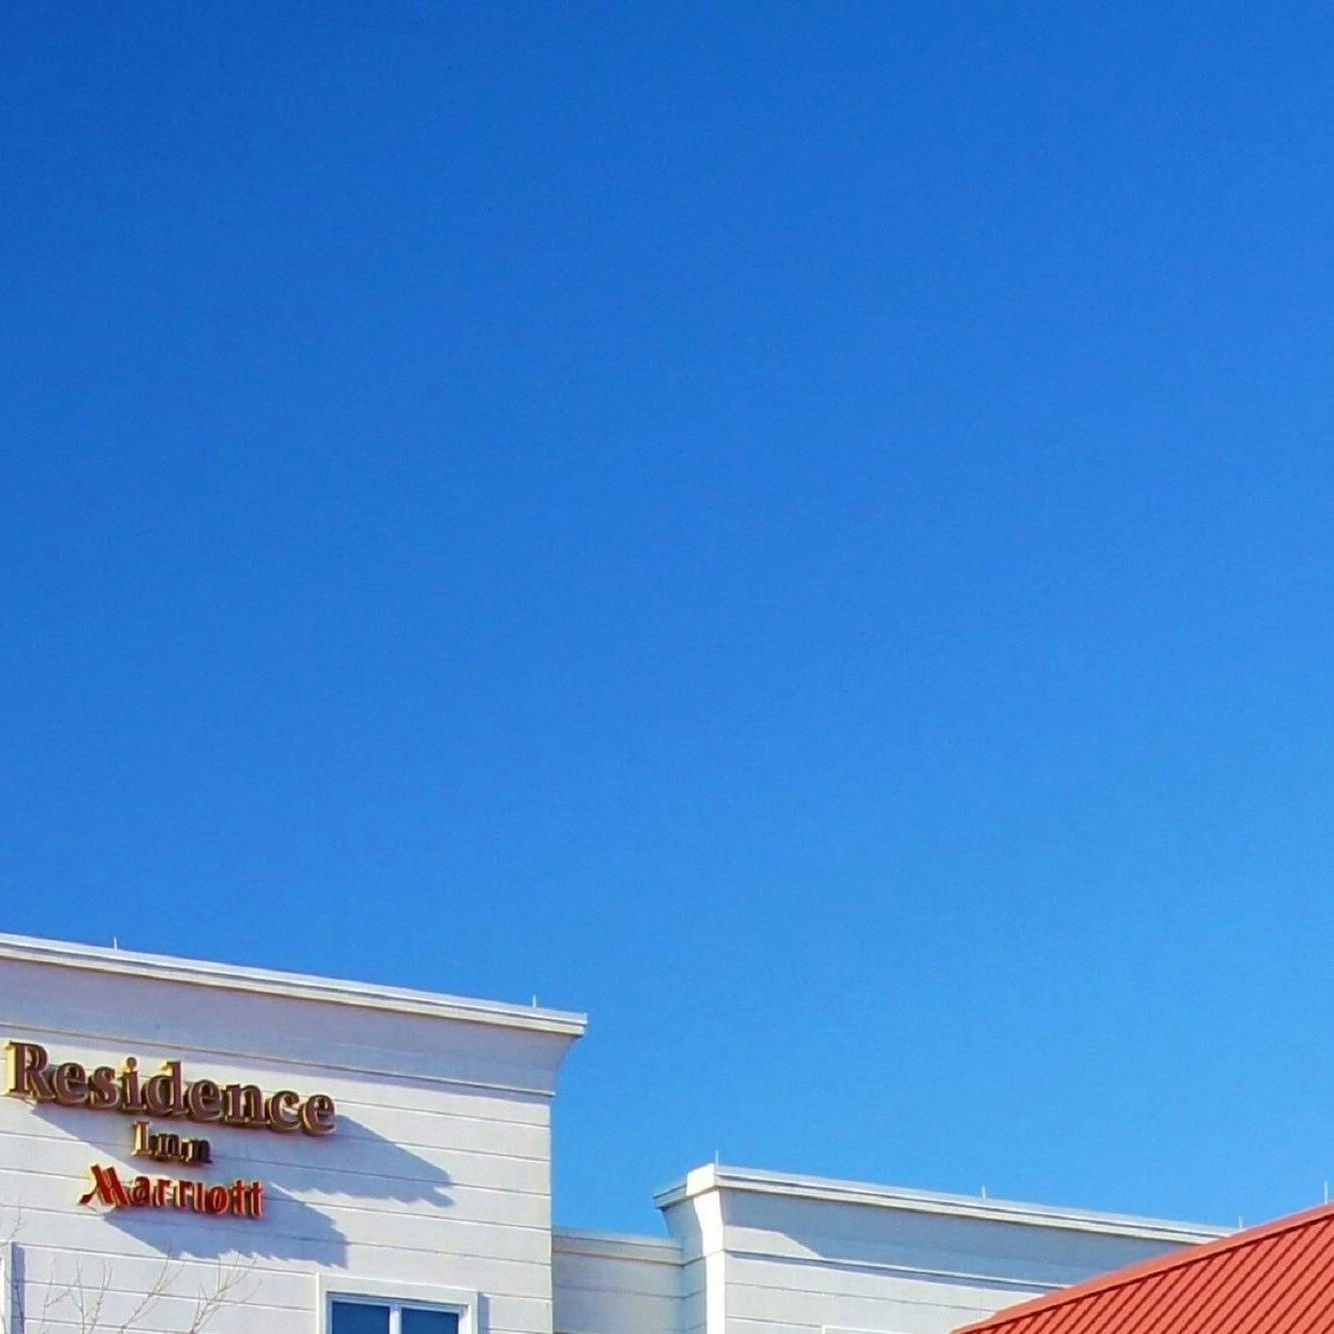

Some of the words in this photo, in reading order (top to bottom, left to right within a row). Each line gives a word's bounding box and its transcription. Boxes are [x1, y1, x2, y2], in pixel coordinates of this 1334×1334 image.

[4, 1040, 338, 1137] Residence
[131, 1120, 213, 1164] Inn
[77, 1164, 265, 1219] Marriott
